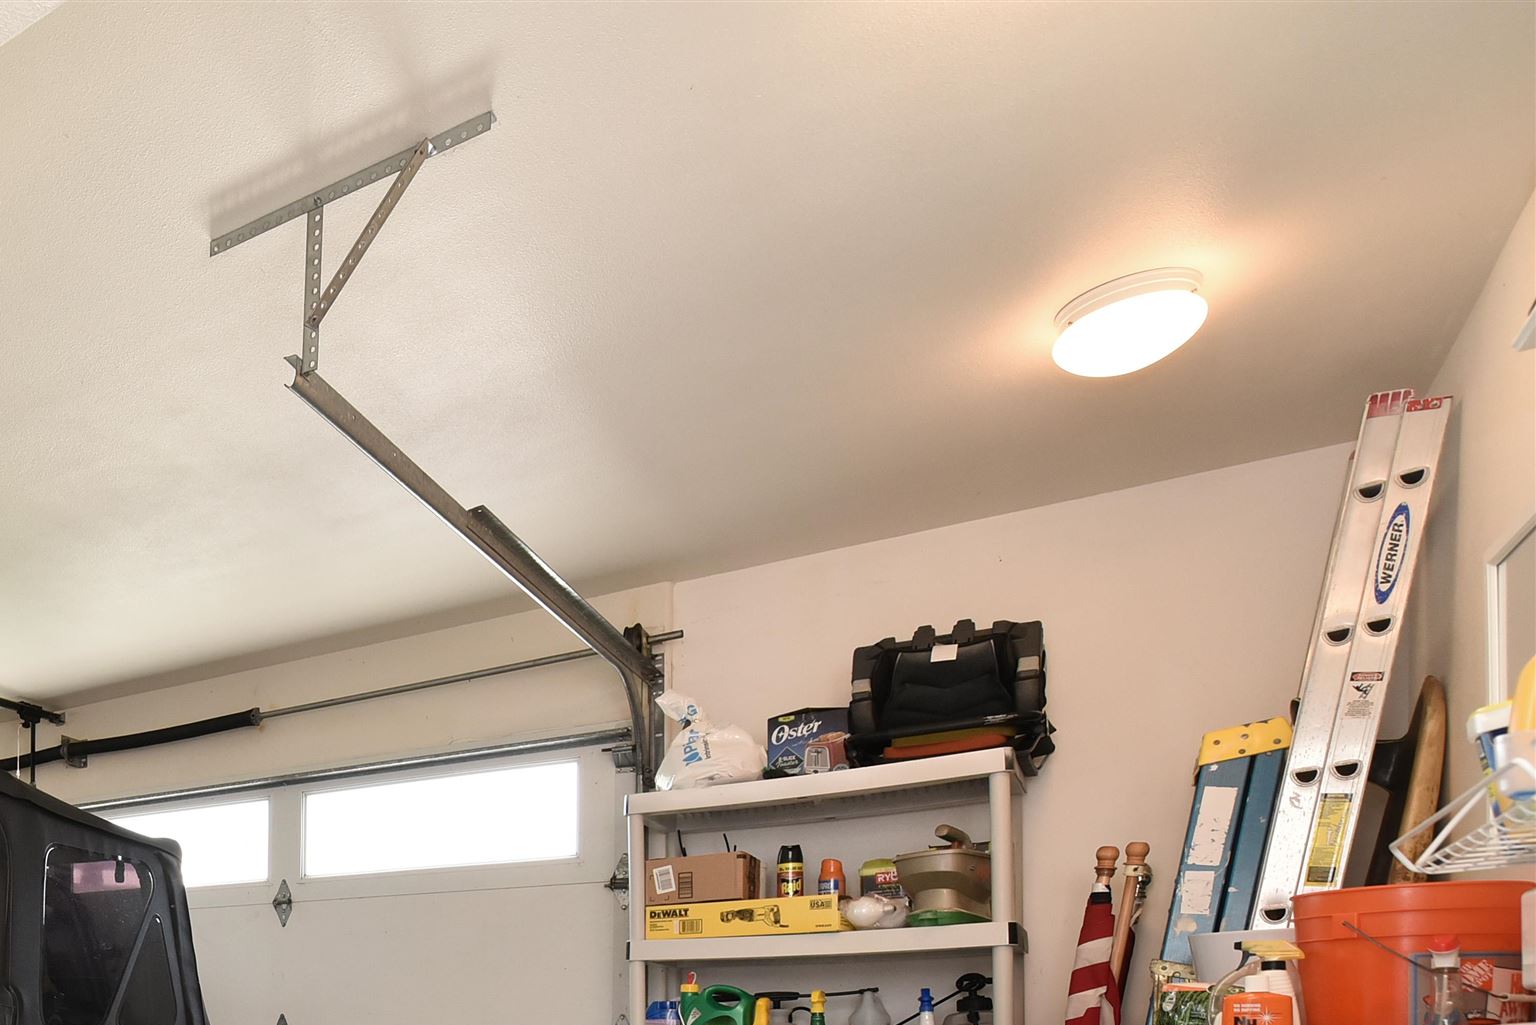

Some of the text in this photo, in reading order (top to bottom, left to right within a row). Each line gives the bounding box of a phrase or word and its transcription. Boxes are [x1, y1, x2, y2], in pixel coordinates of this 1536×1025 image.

[1379, 522, 1404, 586] WERNER
[771, 719, 822, 746] Oster
[782, 880, 801, 893] Raid
